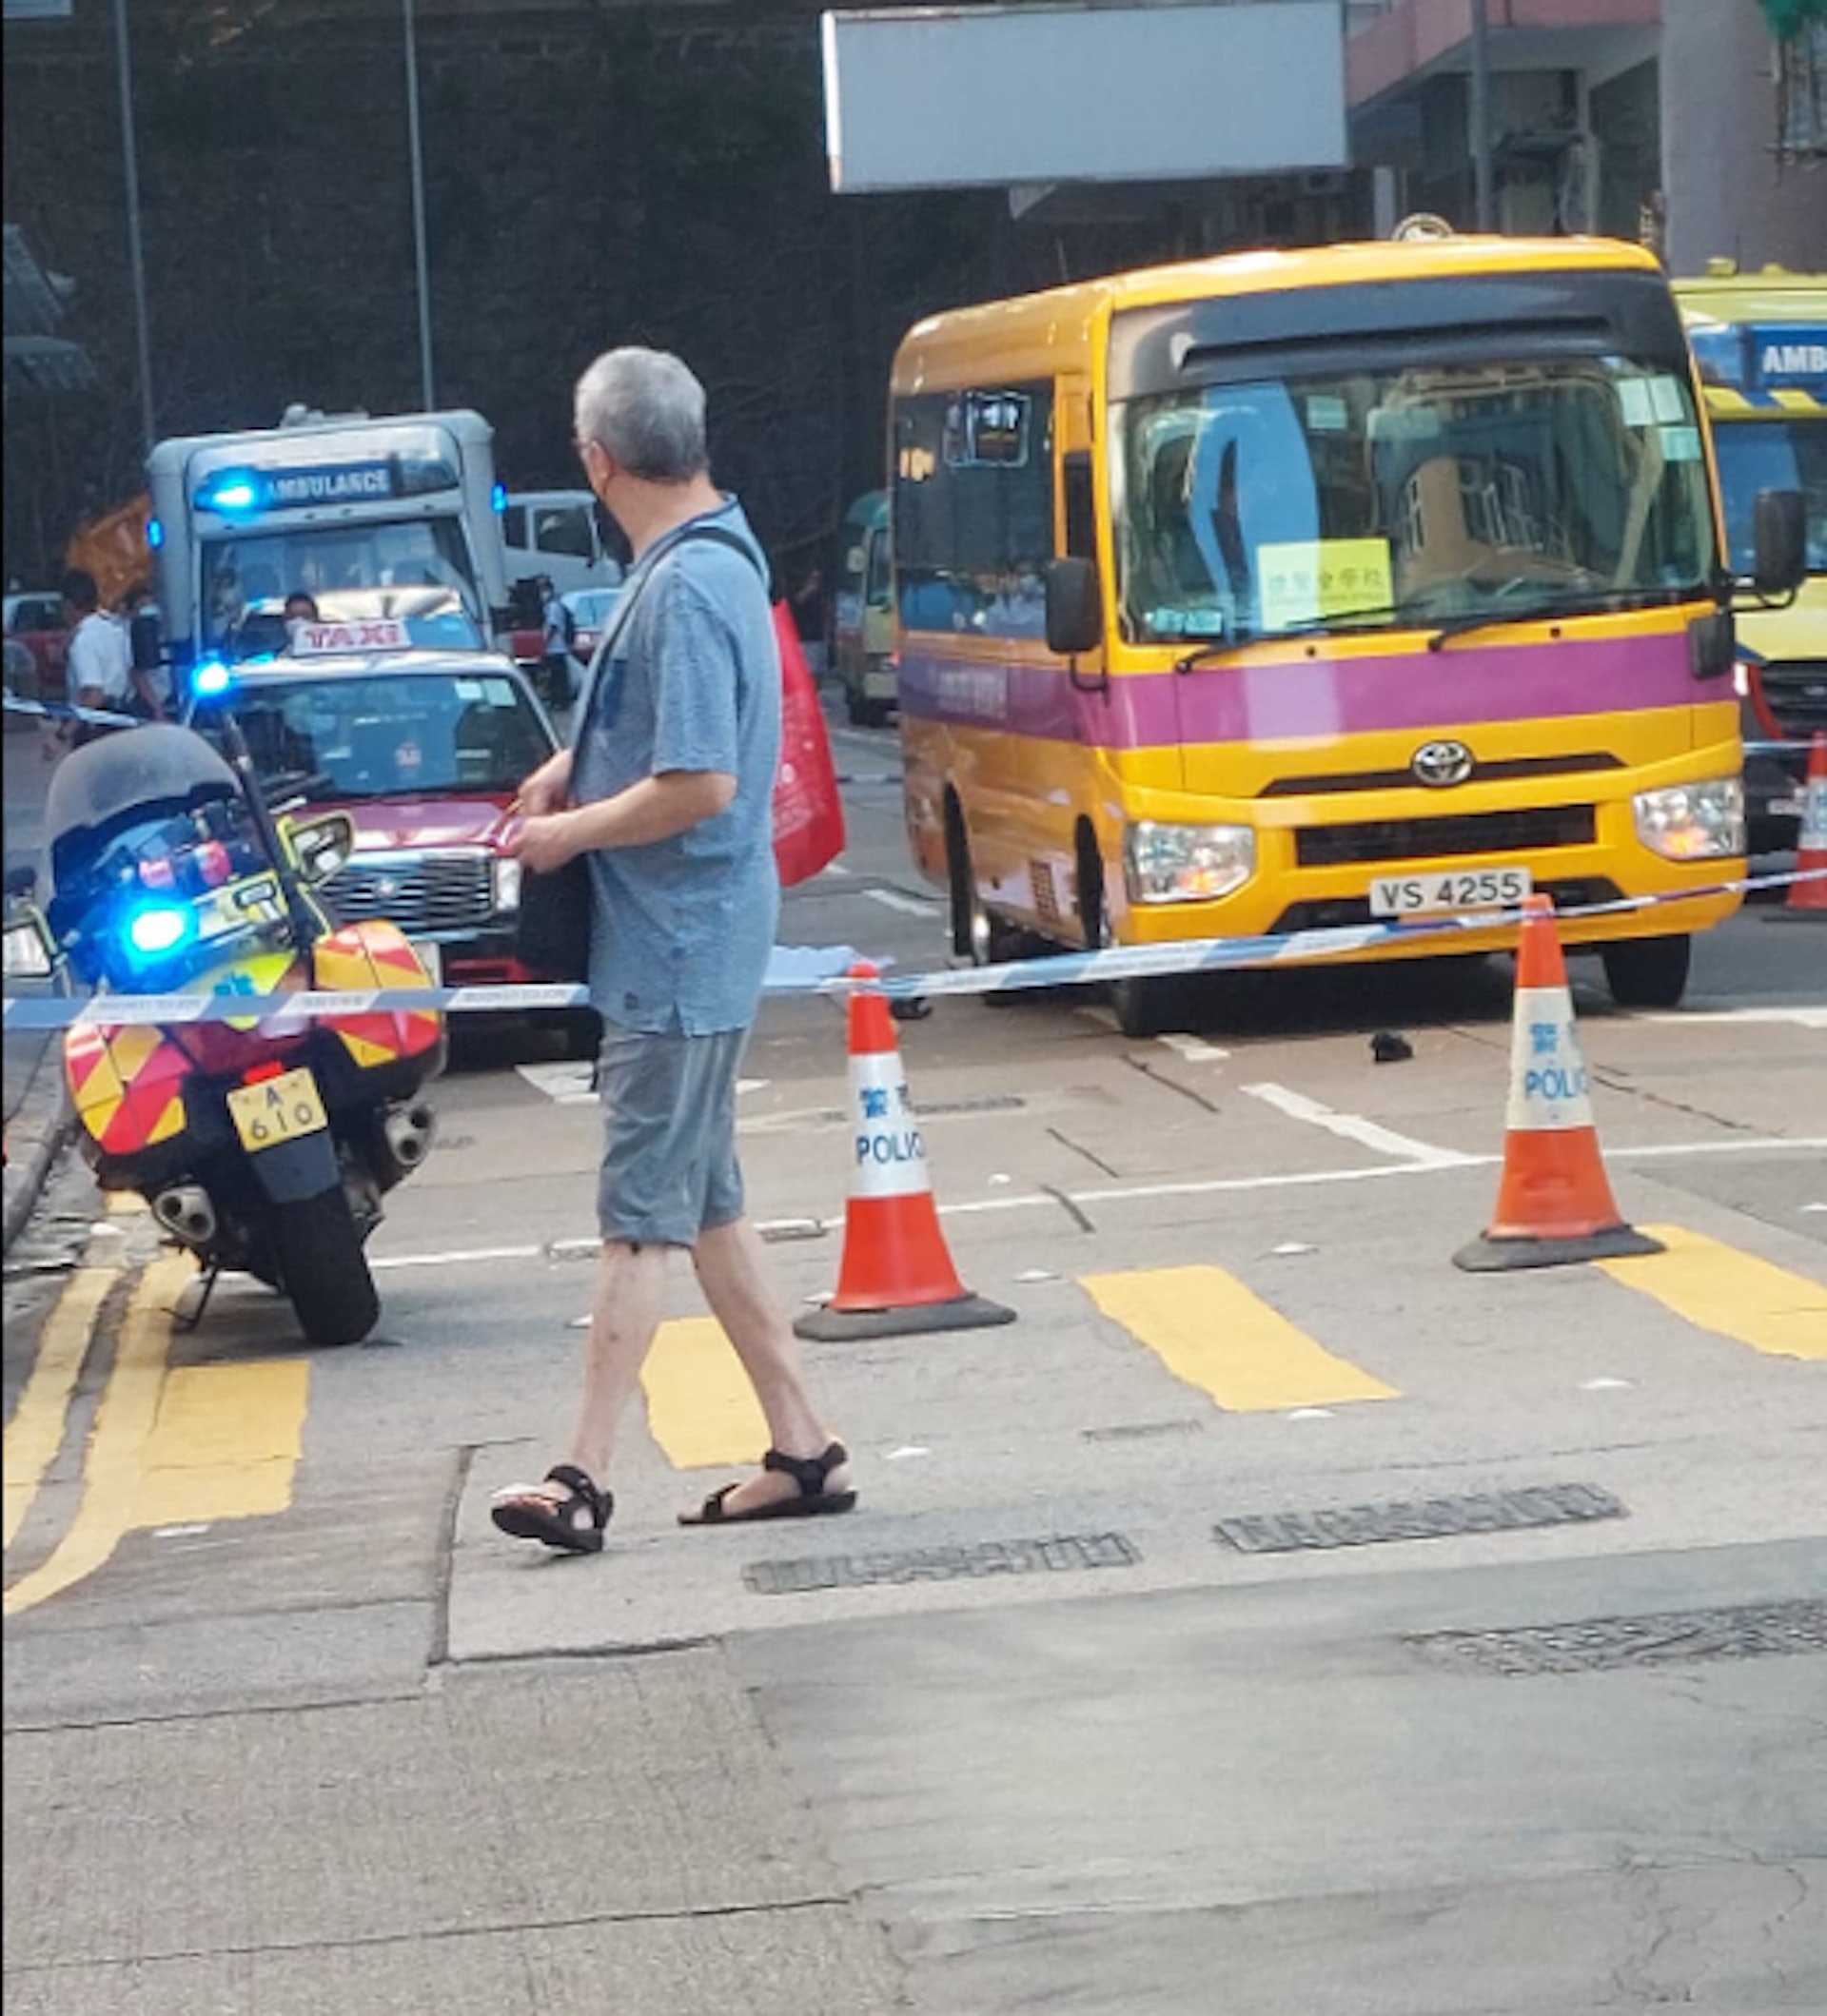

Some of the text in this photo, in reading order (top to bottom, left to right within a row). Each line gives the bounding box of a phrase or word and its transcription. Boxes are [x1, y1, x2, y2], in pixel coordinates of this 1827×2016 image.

[304, 624, 400, 649] TAXI
[1381, 872, 1522, 909] VS 4255
[265, 1086, 284, 1108] A
[250, 1104, 313, 1140] 610
